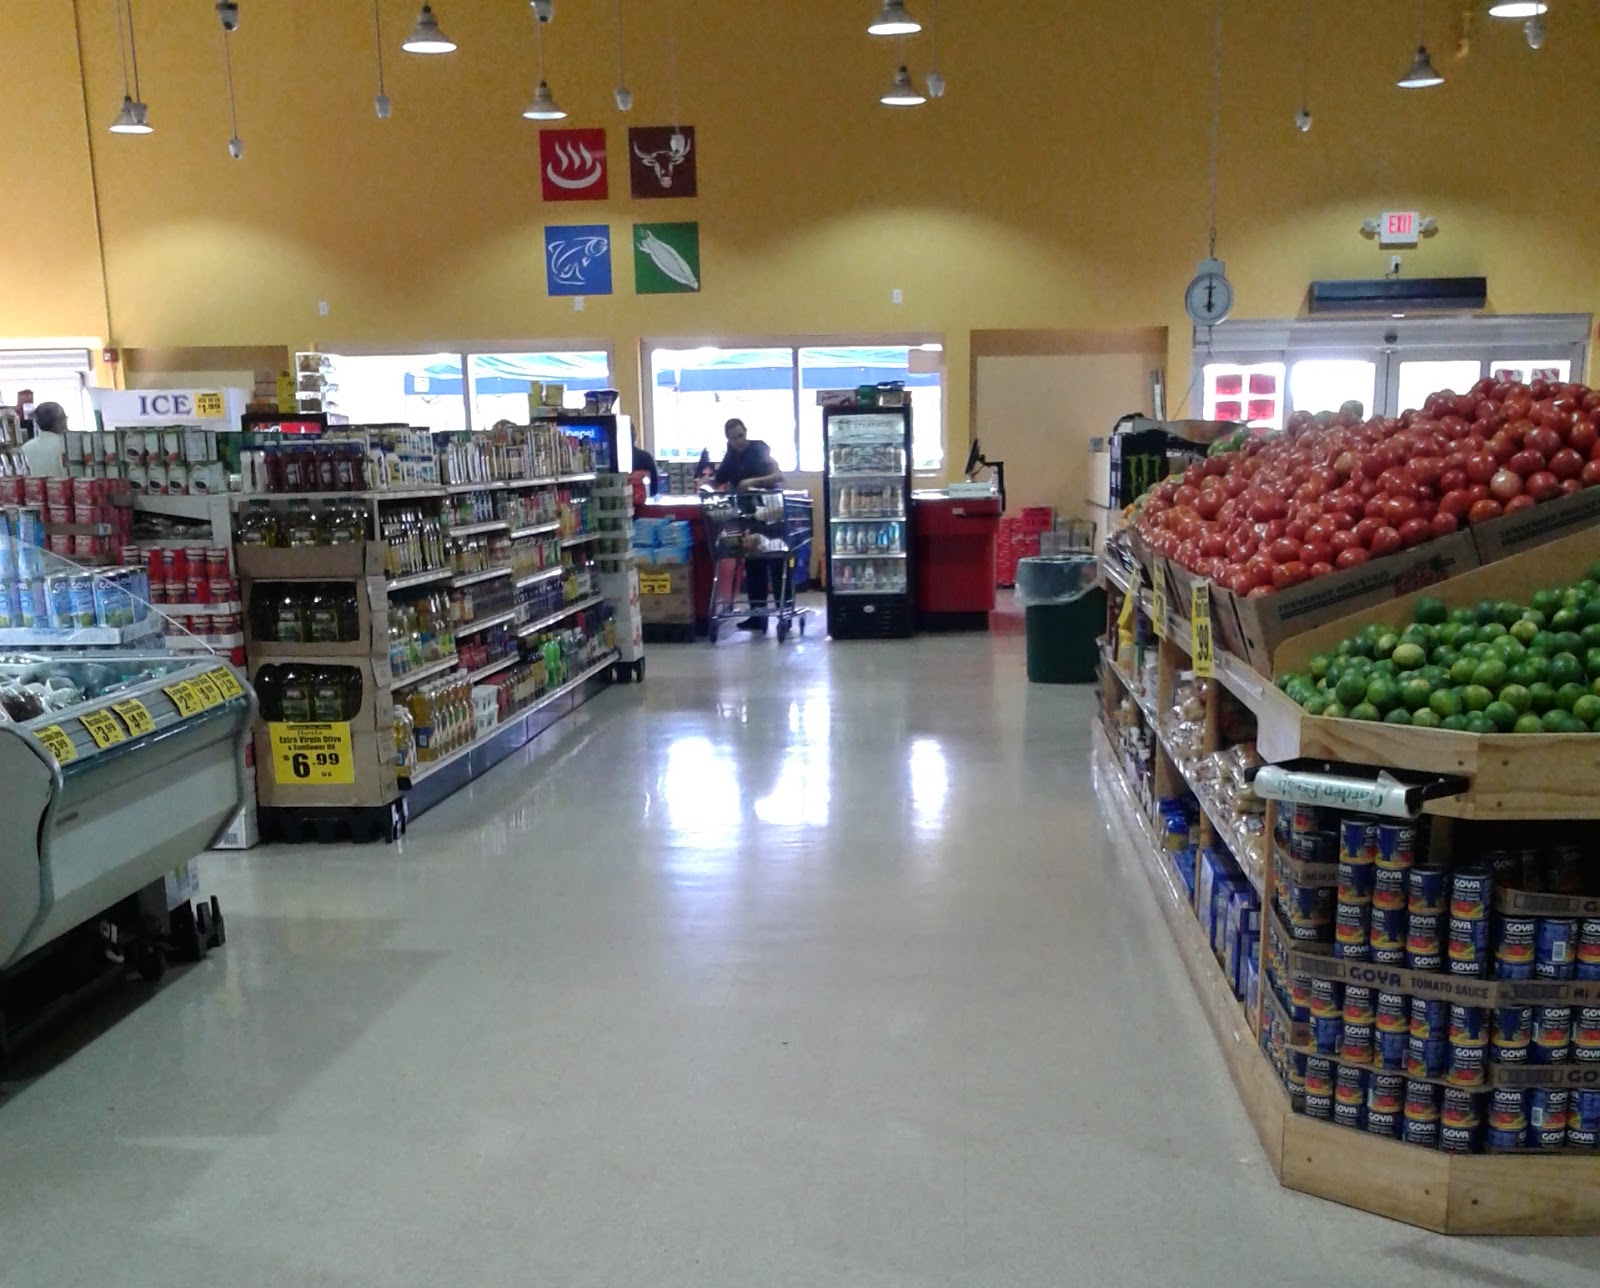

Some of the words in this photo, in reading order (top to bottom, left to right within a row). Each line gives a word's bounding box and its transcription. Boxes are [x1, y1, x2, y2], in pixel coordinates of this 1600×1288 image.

[1388, 213, 1413, 234] EXIT
[138, 394, 192, 416] ICE
[299, 736, 322, 744] Virgin
[1376, 869, 1403, 880] GOYA
[1454, 878, 1481, 889] GOYA
[1409, 915, 1436, 925] GOYA
[1506, 922, 1535, 932] GOYA
[1451, 961, 1479, 971] GOYA
[1349, 966, 1401, 988] GOYA
[1411, 977, 1452, 993] TOMATO
[1455, 984, 1490, 999] SAUCE
[1345, 985, 1370, 995] GOYA
[1344, 1026, 1370, 1036] GOYA
[1455, 1048, 1483, 1058] GOYA
[1407, 1082, 1432, 1092] GOYA
[1306, 1096, 1330, 1106] GOYA
[1494, 1091, 1521, 1101] GOYA
[1368, 1112, 1394, 1123] GOYA
[1408, 1122, 1436, 1132] GOYA
[1443, 1128, 1469, 1139] GOYA
[1568, 1130, 1594, 1141] GOYA
